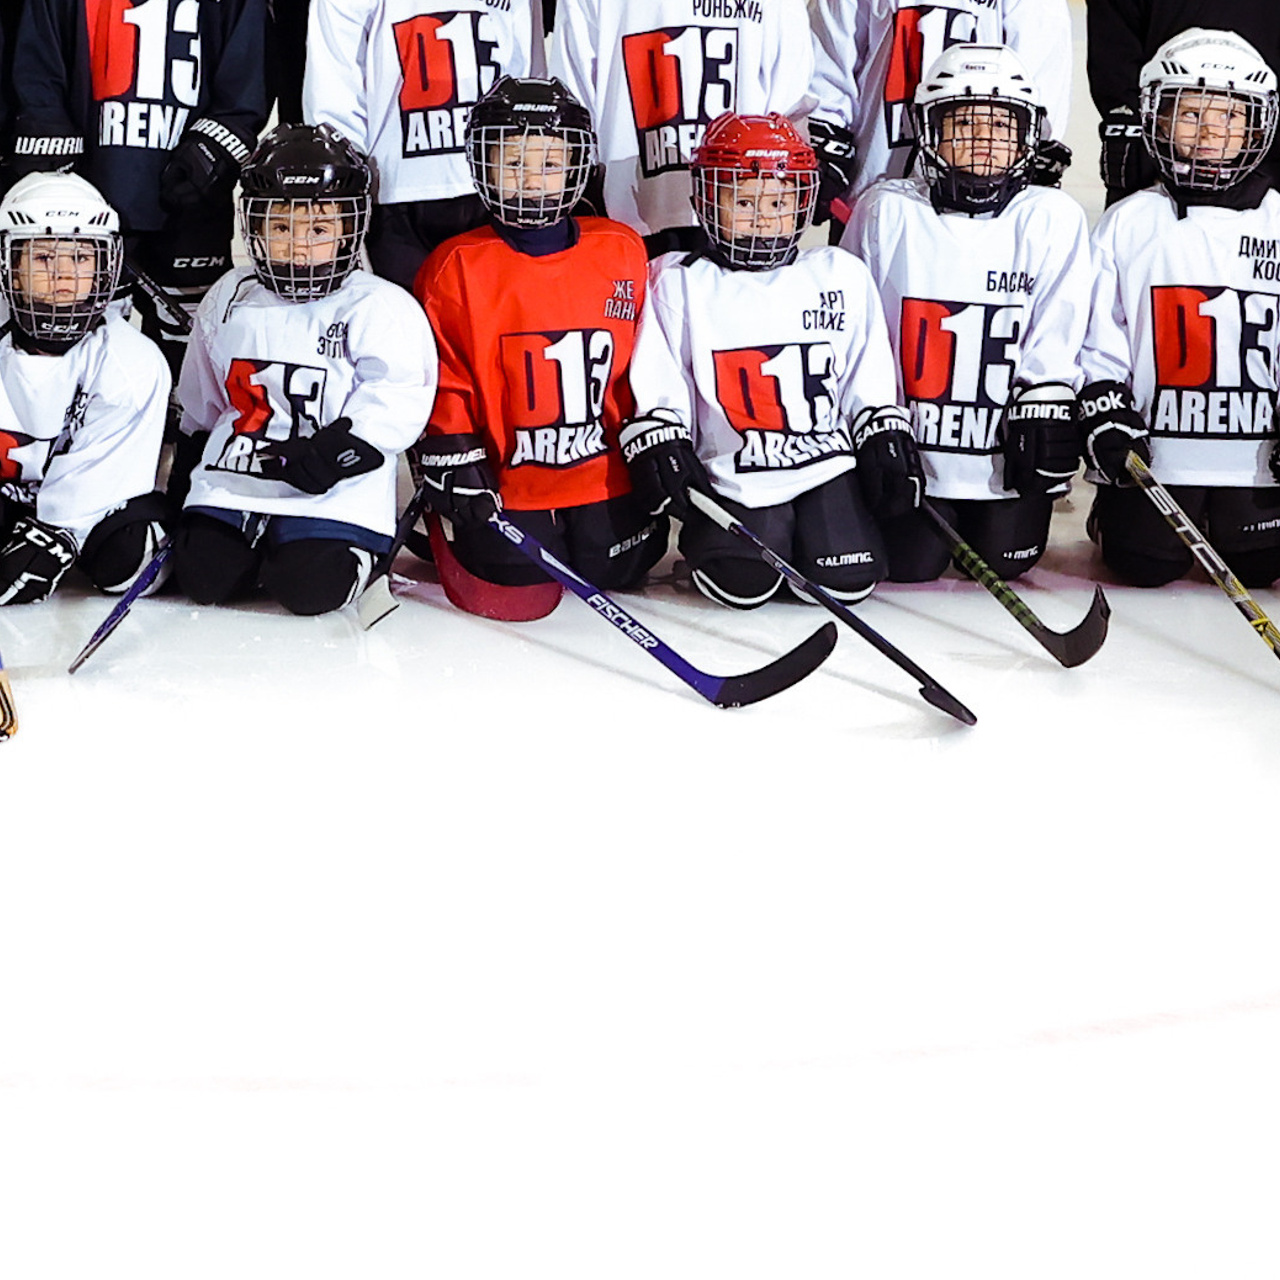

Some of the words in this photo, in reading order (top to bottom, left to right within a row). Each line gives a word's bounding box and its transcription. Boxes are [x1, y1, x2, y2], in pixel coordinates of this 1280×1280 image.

[393, 11, 503, 110] D13
[622, 26, 737, 129] D13
[405, 108, 473, 152] ARE
[512, 104, 558, 113] BAUER
[1105, 123, 1144, 138] CC
[744, 148, 790, 158] BAUER
[283, 175, 320, 186] CCM
[1238, 235, 1280, 260] ДМИ
[899, 298, 1024, 406] D13
[1152, 285, 1280, 393] D13
[500, 330, 614, 428] D13
[712, 343, 840, 433] D13
[1153, 388, 1277, 435] ARENA
[511, 421, 608, 467] ARENA
[738, 414, 853, 469] ARENA
[586, 592, 660, 652] FISCHER
